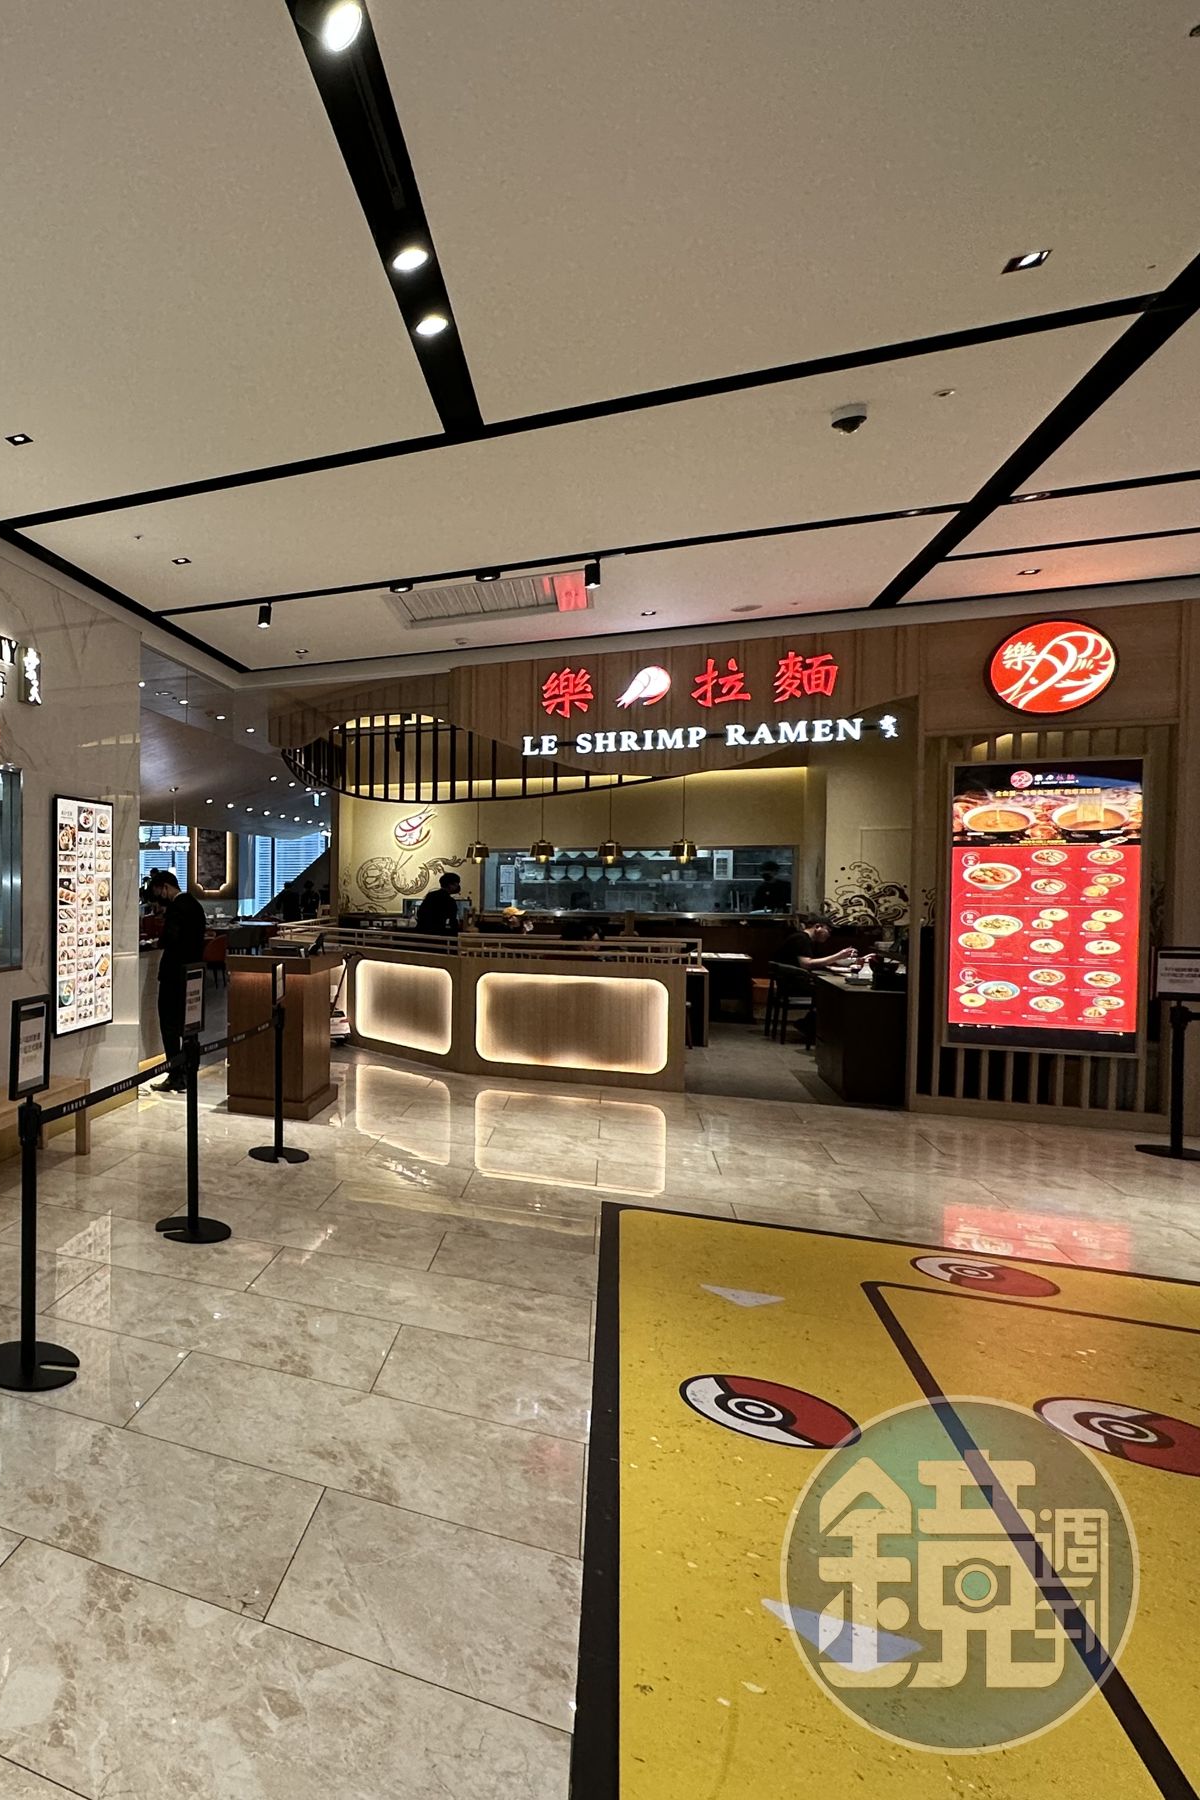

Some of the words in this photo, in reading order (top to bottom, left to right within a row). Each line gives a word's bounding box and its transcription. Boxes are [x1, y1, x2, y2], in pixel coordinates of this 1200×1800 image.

[522, 734, 559, 757] LE
[575, 725, 708, 755] SHRIMP
[725, 717, 865, 747] RAMEN
